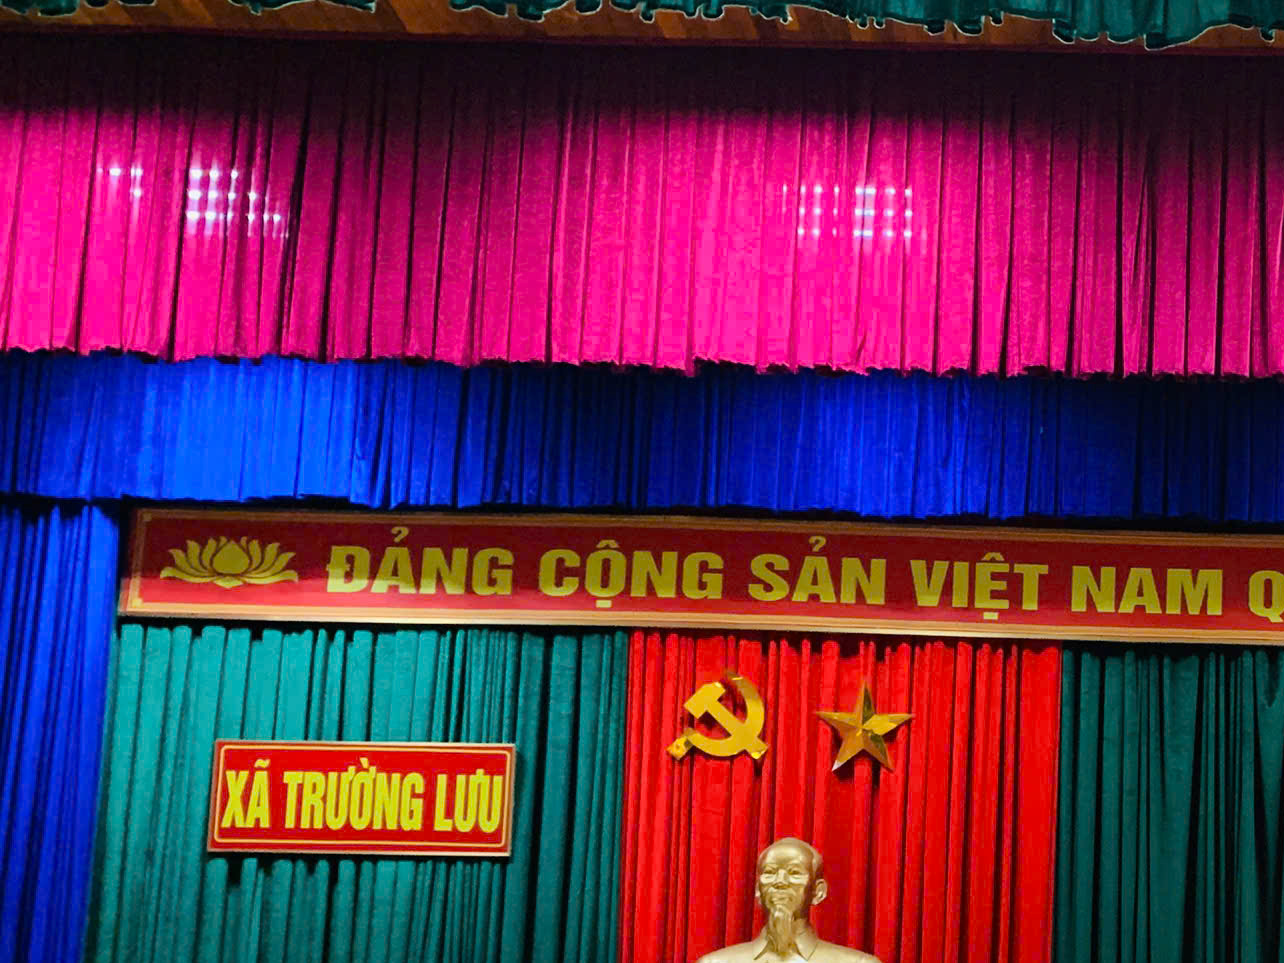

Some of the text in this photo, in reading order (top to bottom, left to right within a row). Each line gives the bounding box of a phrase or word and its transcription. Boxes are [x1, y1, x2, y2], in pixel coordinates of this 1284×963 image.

[324, 527, 513, 600] ĐẢNG
[531, 540, 723, 612] CỘNG
[749, 536, 886, 605] SẢN
[905, 552, 1048, 625] VIỆT
[1071, 566, 1222, 615] NAM
[220, 756, 503, 833] XÃ TRƯỜNG LƯU
